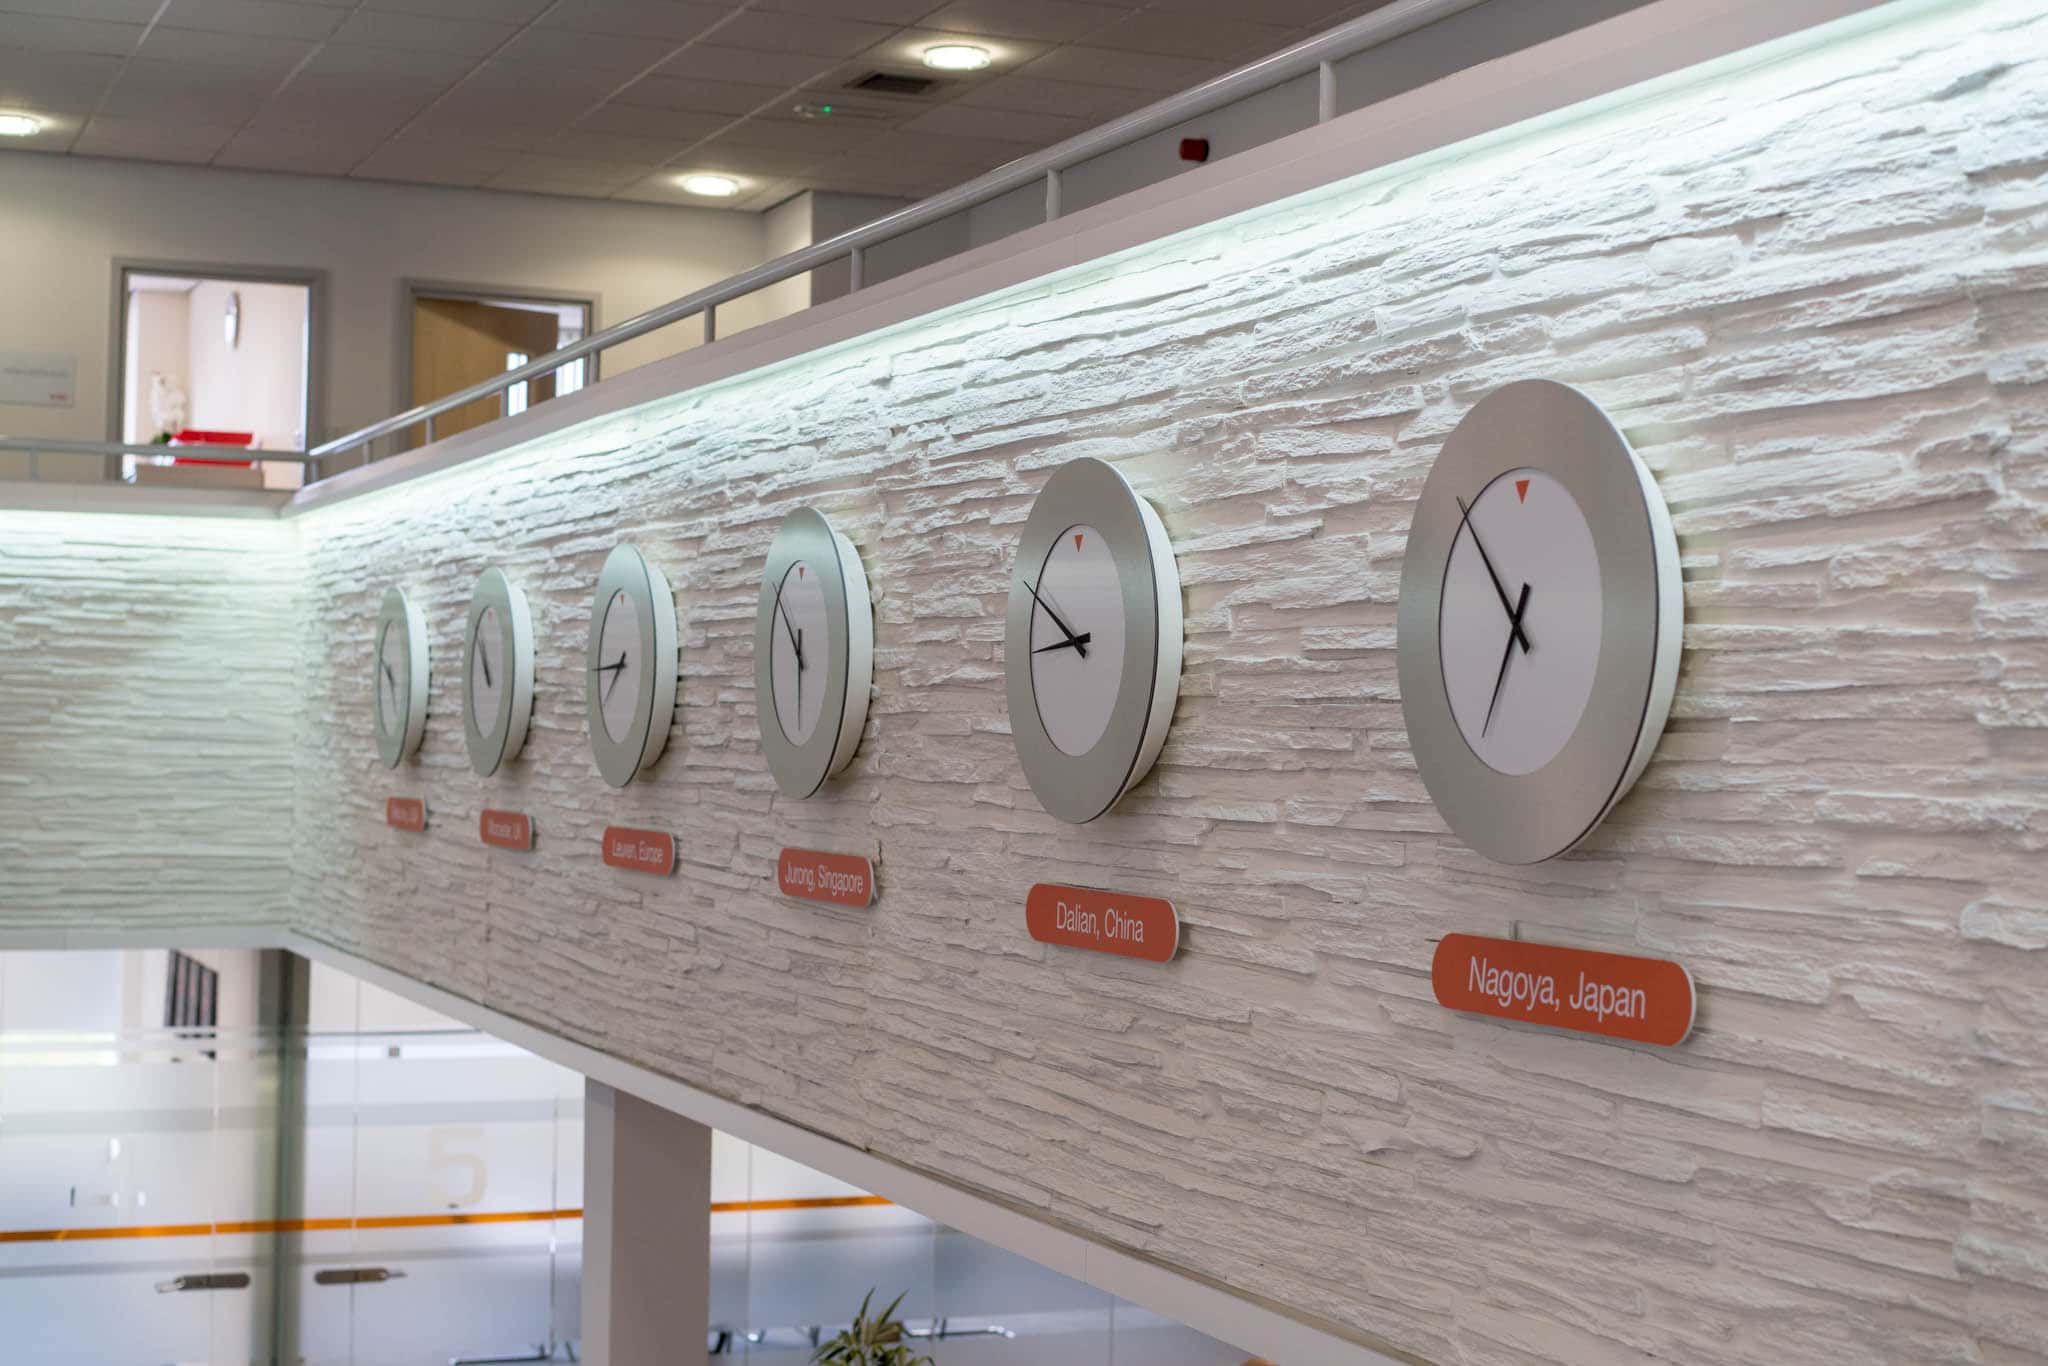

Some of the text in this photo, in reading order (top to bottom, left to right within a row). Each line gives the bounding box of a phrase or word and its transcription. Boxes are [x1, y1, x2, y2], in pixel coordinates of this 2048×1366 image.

[818, 864, 864, 897] Singapore
[1056, 901, 1144, 943] Dalian, China
[1468, 956, 1646, 1023] Nagoya, Japan
[430, 1126, 488, 1208] 5
